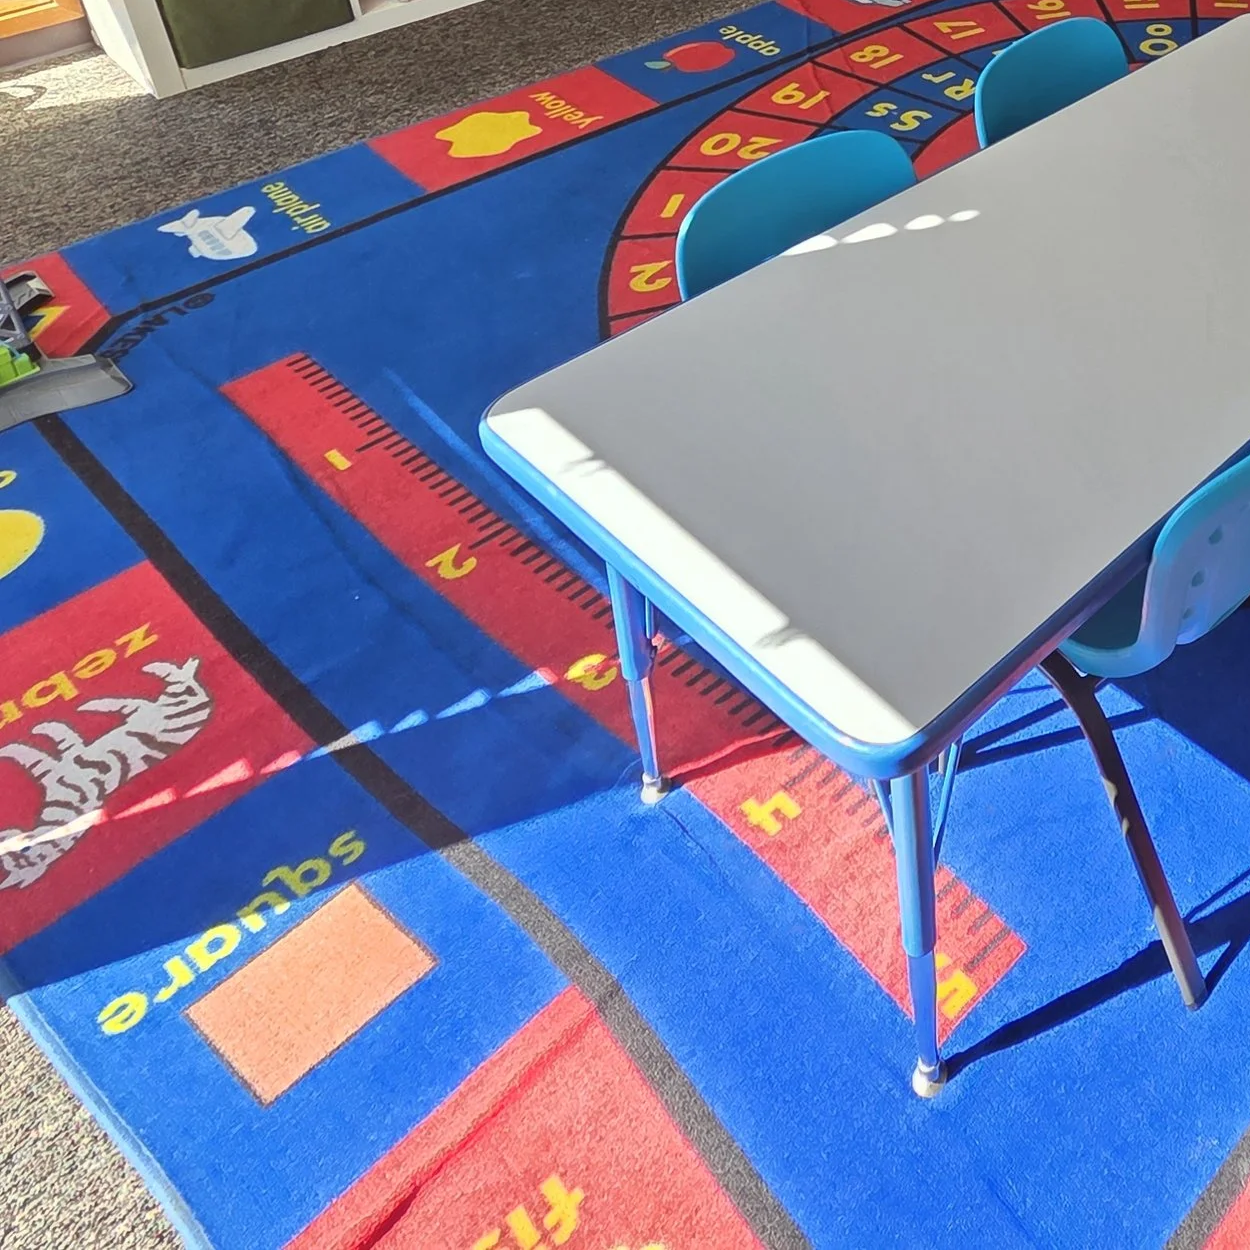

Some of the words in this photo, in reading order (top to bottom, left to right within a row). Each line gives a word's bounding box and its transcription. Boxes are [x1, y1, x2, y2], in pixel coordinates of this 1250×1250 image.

[719, 24, 781, 57] apple
[933, 20, 984, 40] 17
[850, 44, 904, 69] 18
[530, 91, 606, 129] yellow
[771, 82, 830, 110] 19
[699, 132, 782, 160] 20
[262, 180, 331, 235] airplane
[629, 260, 672, 293] 2
[426, 544, 478, 580] 2
[0, 621, 160, 730] zebr
[565, 653, 619, 691] 3
[739, 791, 803, 835] 4
[97, 830, 367, 1036] square
